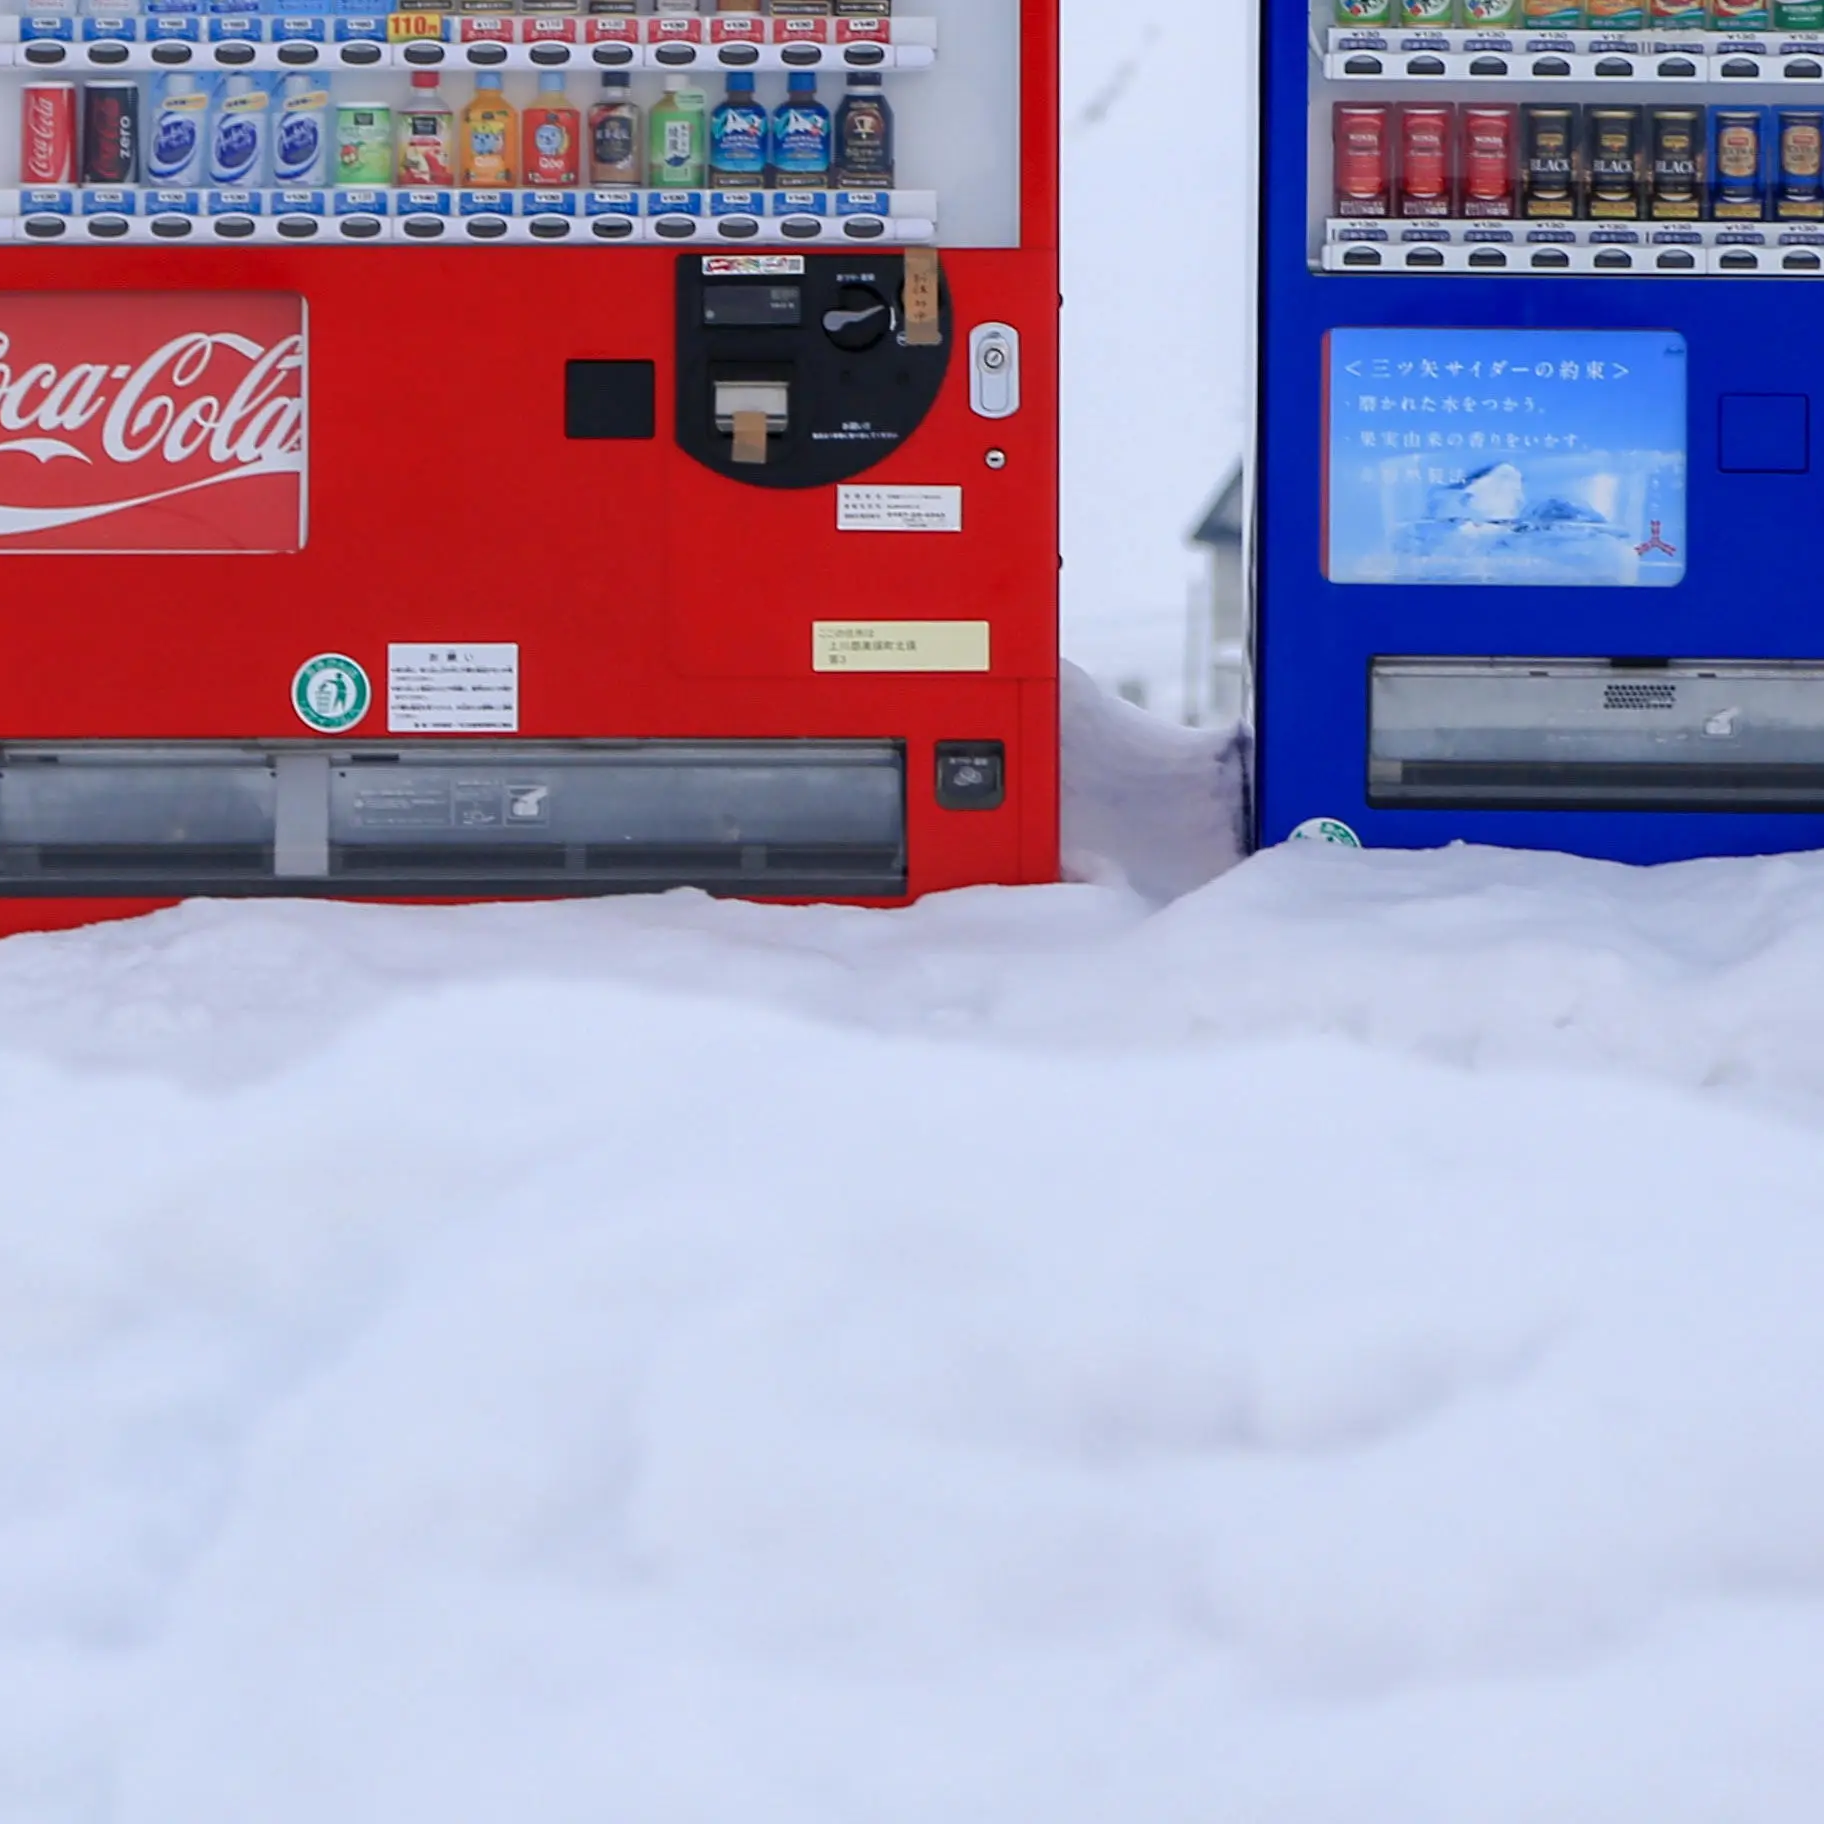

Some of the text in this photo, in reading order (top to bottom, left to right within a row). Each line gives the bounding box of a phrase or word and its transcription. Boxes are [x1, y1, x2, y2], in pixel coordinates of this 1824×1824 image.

[119, 115, 132, 159] zero
[1529, 158, 1571, 172] BLACK
[1593, 159, 1634, 173] BLACK
[1655, 160, 1694, 173] BLACK
